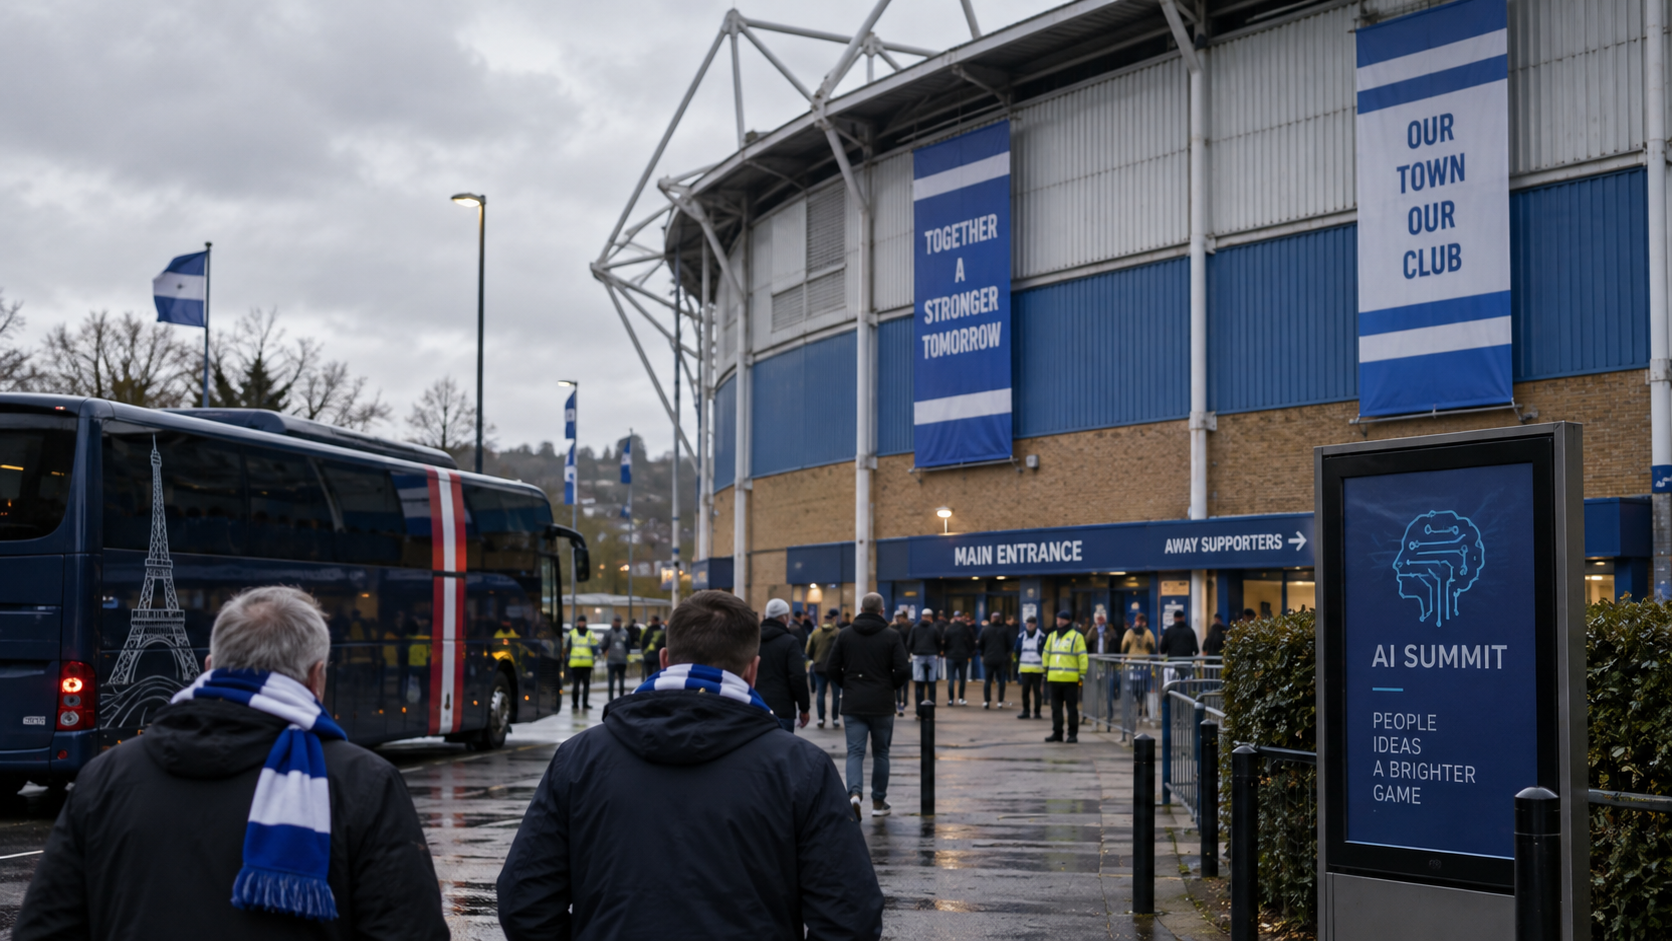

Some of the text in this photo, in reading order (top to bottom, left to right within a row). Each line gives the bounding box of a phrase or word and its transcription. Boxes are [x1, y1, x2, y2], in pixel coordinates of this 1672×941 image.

[1407, 112, 1454, 149] OUR
[1396, 152, 1465, 194] TOWN
[1408, 200, 1456, 236] OUR
[924, 213, 998, 255] TOGETHER
[954, 257, 966, 283] A
[1403, 242, 1462, 280] CLUB
[923, 286, 999, 325] STRONGER
[922, 321, 1002, 359] TOMORROW
[954, 540, 1083, 566] MAIN ENTRANCE
[1164, 533, 1283, 554] AWAY SUPPORTERS
[1371, 644, 1508, 670] AI SUMMIT
[1373, 711, 1437, 731] PEOPLE
[1373, 736, 1422, 755] IDEAS
[1373, 760, 1476, 784] A BRIGHTER
[1373, 784, 1422, 805] GAME
